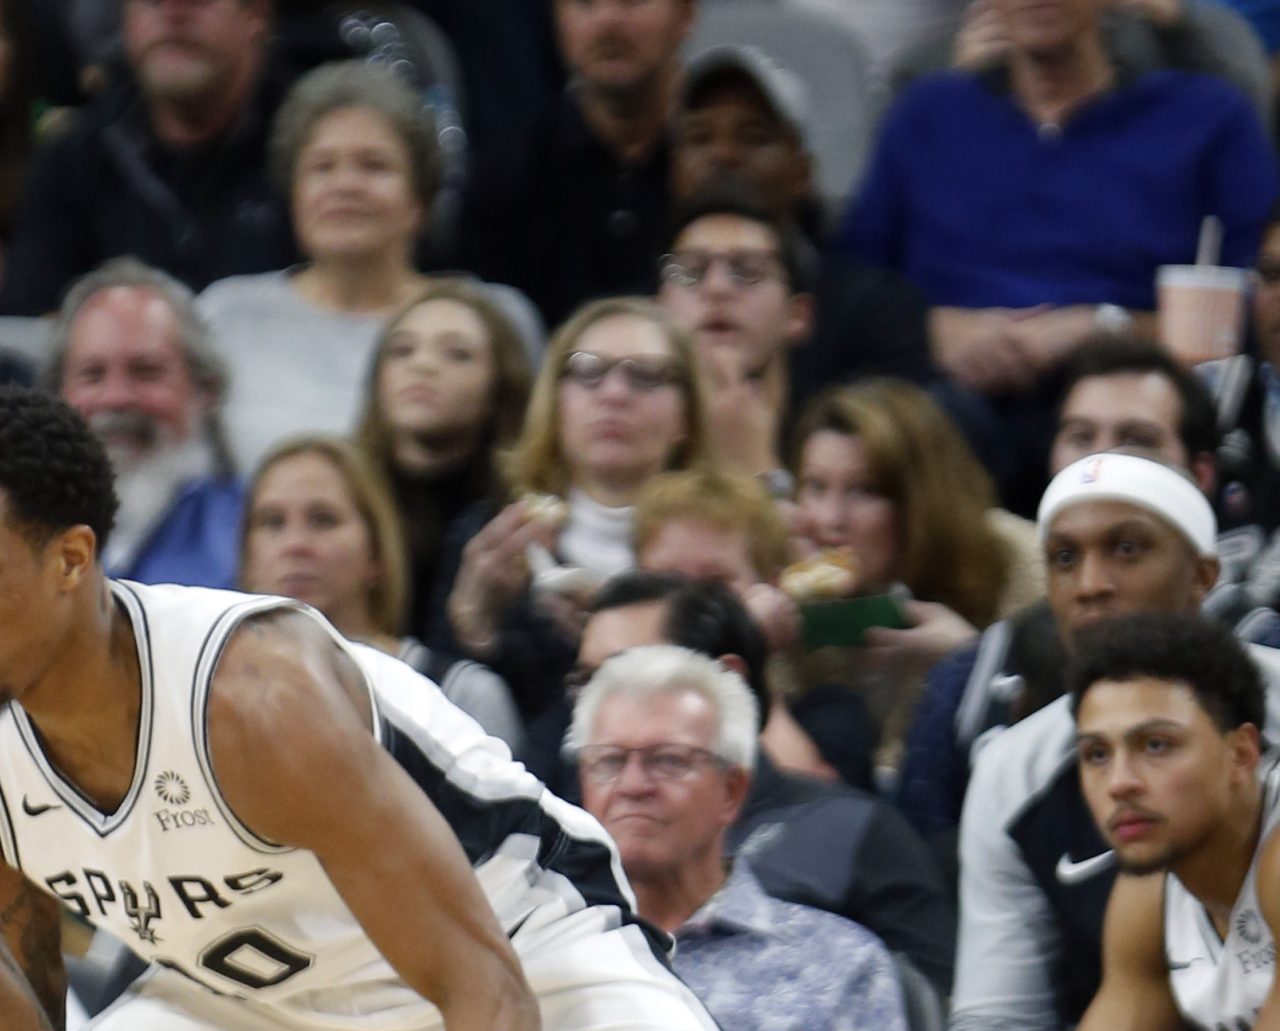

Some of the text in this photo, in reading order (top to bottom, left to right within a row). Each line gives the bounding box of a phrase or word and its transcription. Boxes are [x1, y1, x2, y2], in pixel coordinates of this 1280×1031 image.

[153, 807, 216, 832] Frost
[44, 867, 284, 944] SPURS
[160, 924, 316, 996] 0
